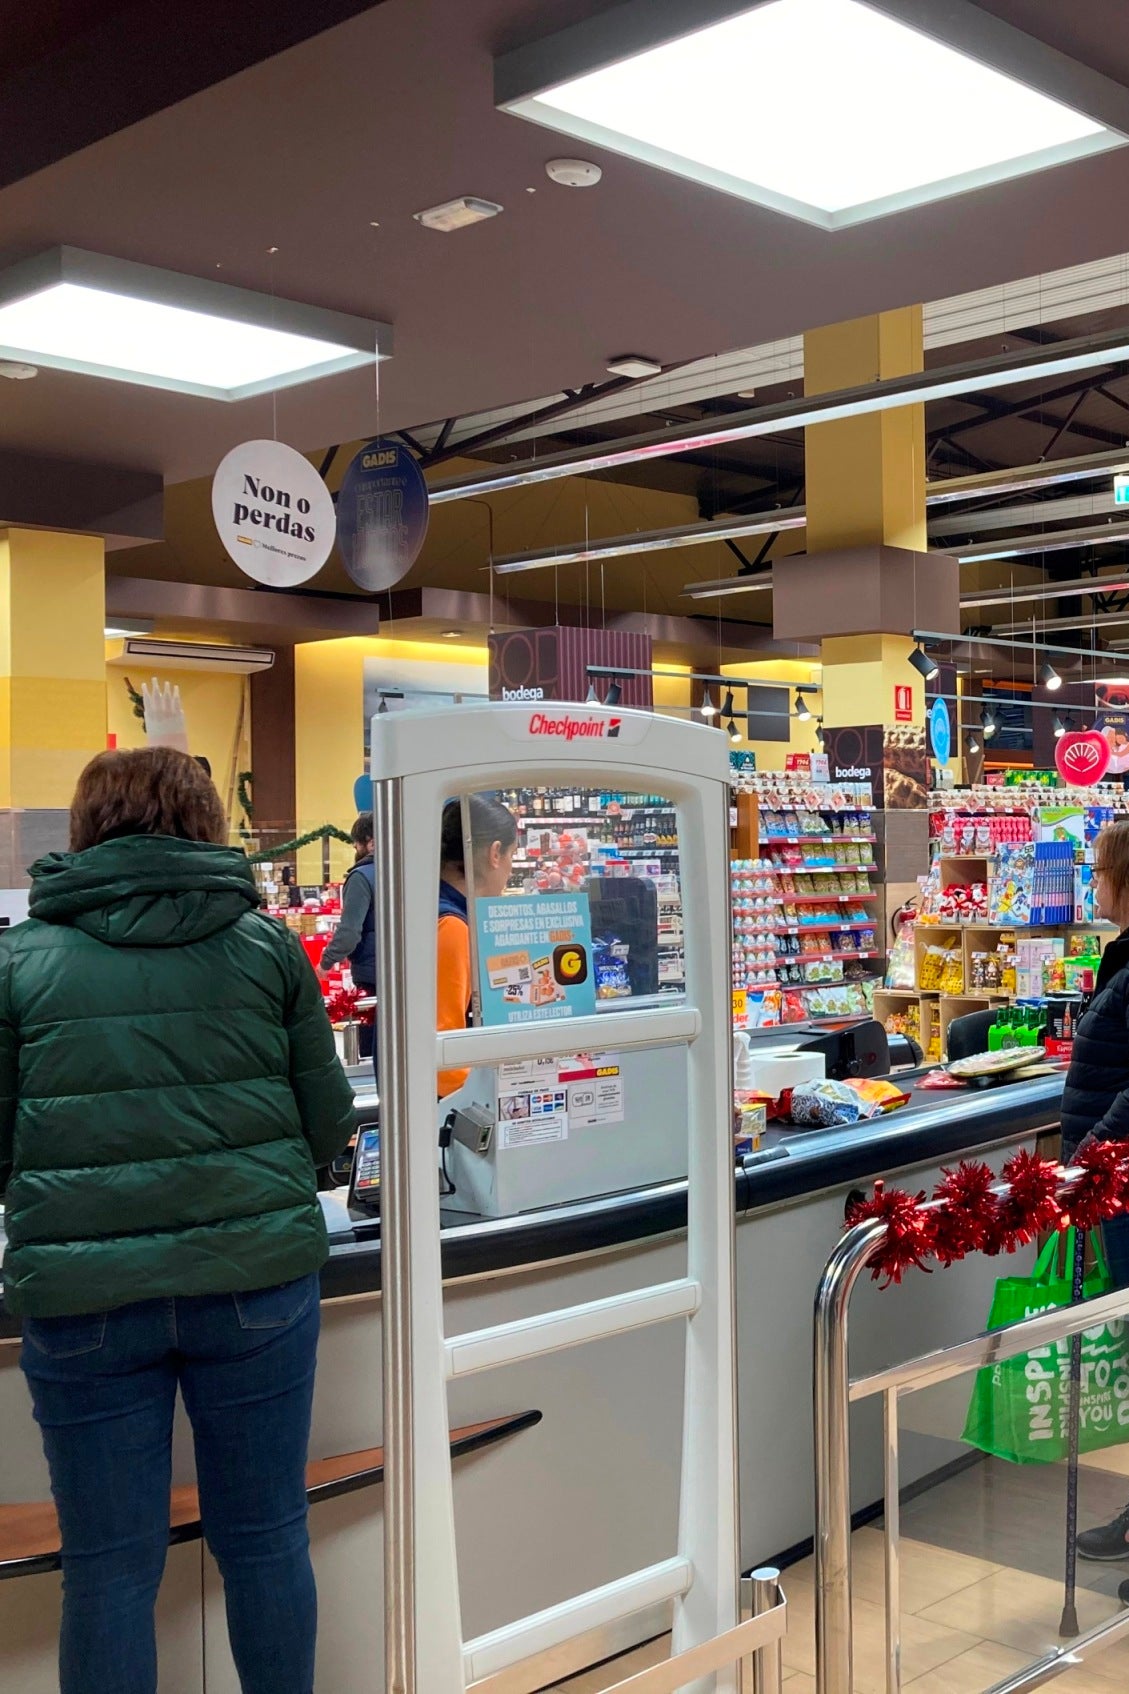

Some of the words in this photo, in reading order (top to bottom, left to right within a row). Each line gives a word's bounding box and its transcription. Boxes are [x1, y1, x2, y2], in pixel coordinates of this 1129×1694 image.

[362, 451, 396, 468] GADIS
[242, 474, 291, 508] Non
[297, 498, 310, 514] o
[232, 502, 315, 542] perdas
[502, 685, 543, 701] bodega
[529, 713, 605, 741] Checkpoint
[835, 765, 871, 780] bodega
[1078, 1404, 1113, 1428] YOU
